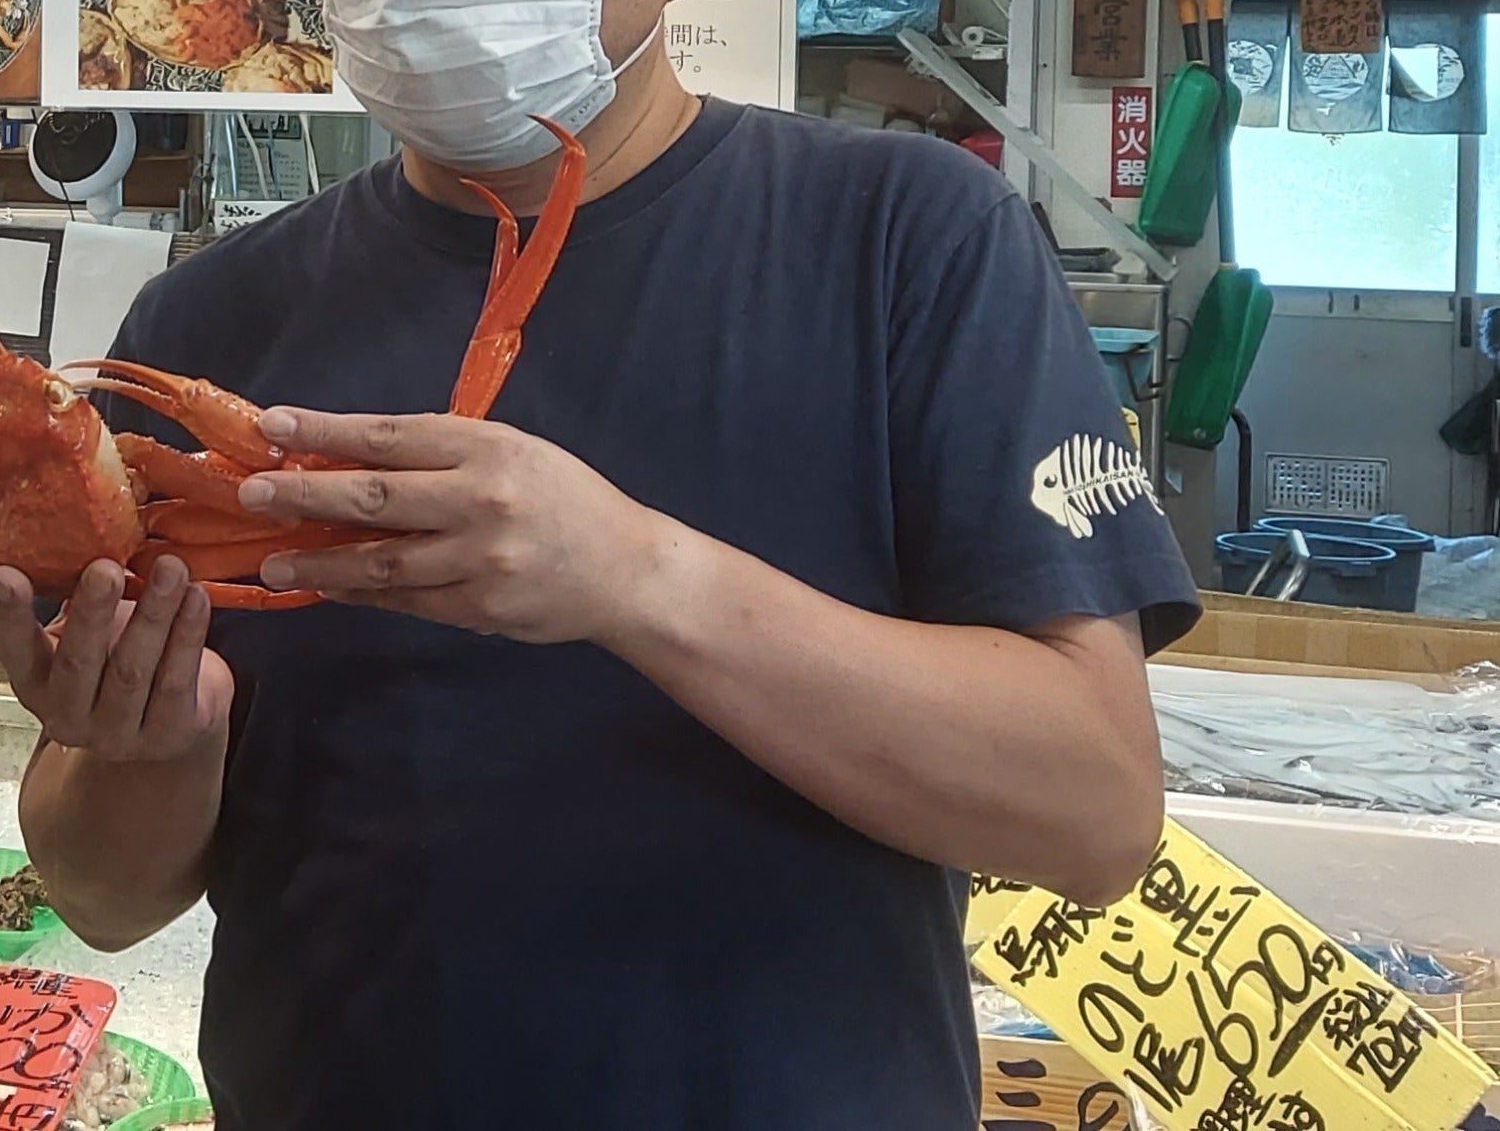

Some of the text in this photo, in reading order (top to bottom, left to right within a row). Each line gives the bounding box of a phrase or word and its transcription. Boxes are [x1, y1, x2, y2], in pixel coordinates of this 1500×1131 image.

[666, 24, 728, 47] 間は、
[1116, 95, 1148, 187] 消火器
